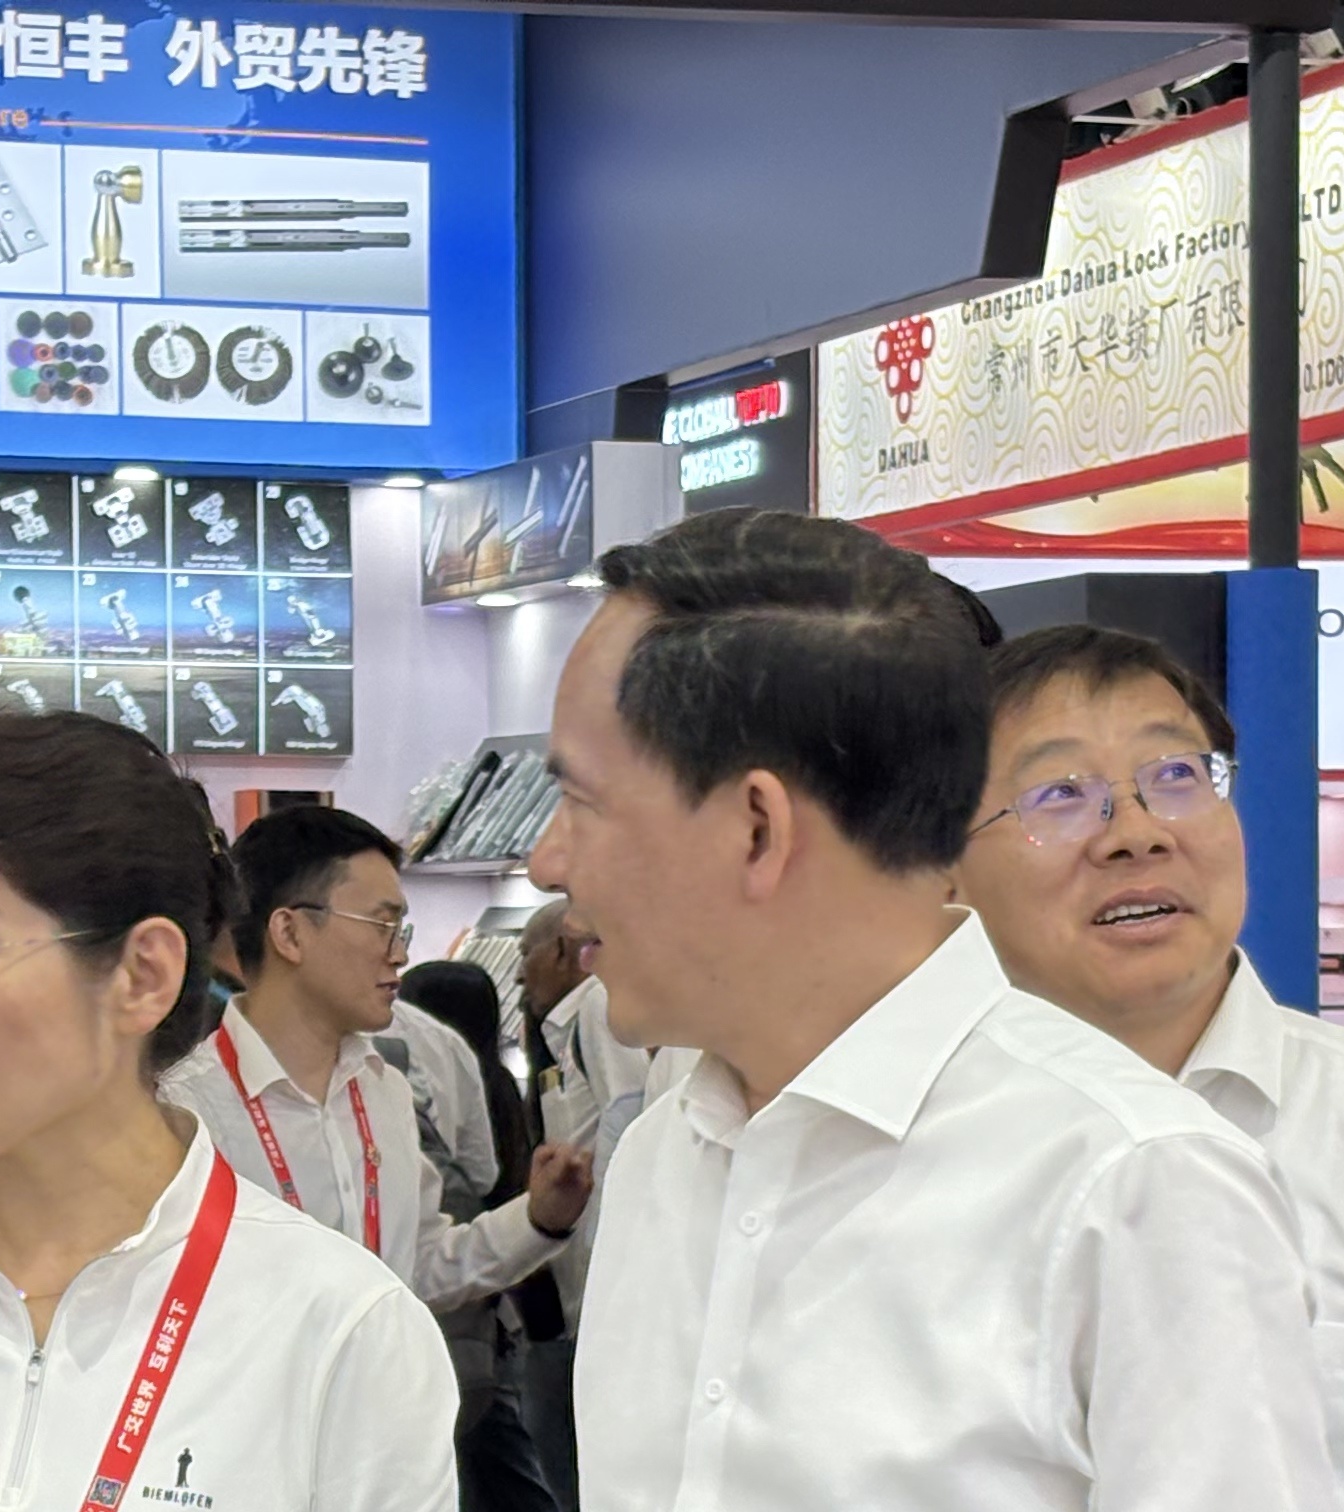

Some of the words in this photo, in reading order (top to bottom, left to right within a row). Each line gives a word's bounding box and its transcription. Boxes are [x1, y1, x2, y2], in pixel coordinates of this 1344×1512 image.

[166, 19, 428, 98] 外贸先锋
[961, 281, 1056, 325] Changzhou
[1061, 258, 1117, 297] Dahua
[1123, 239, 1169, 278] Lock
[1175, 220, 1251, 263] Factory
[1300, 183, 1341, 222] LTD
[878, 438, 930, 474] DAHUA
[117, 1379, 158, 1453] 广交世界
[148, 1297, 189, 1373] 互利天下
